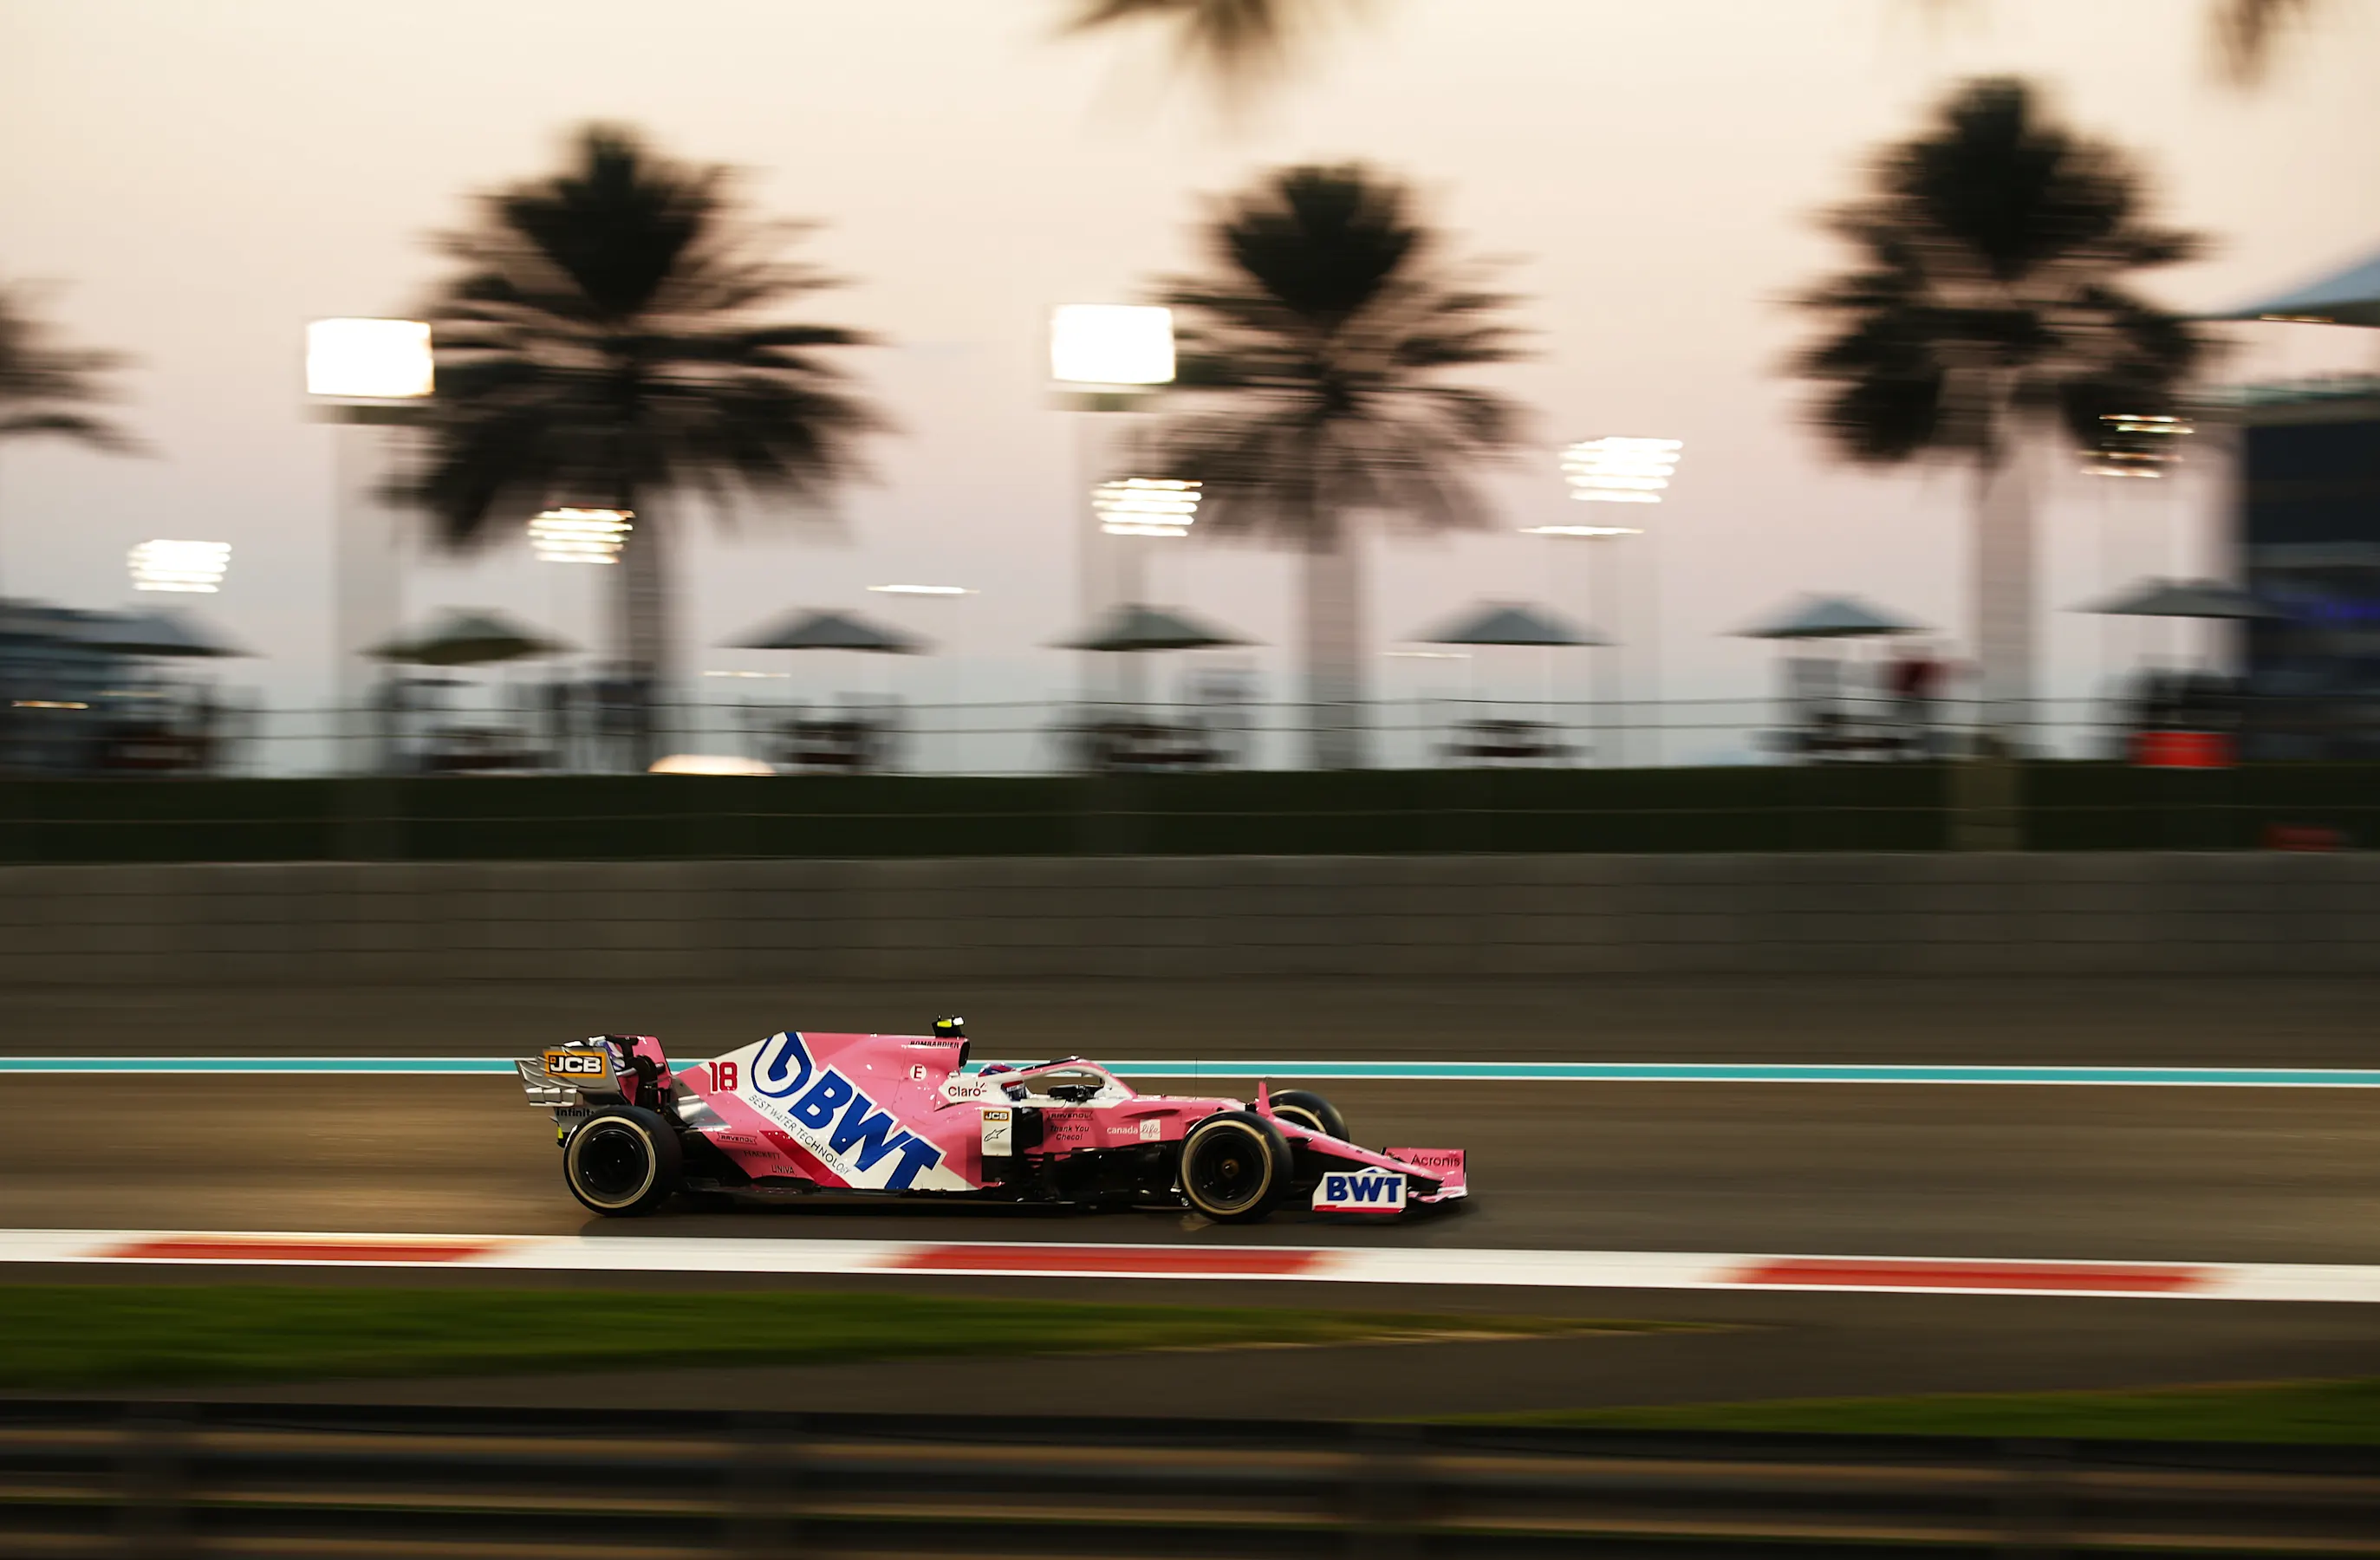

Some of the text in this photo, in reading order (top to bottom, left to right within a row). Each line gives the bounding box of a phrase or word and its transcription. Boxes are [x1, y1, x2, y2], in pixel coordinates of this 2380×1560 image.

[550, 1056, 601, 1072] JCB
[709, 1062, 738, 1091] 18
[914, 1065, 922, 1079] E
[948, 1086, 981, 1097] Claro
[748, 1095, 852, 1175] BEST WATER TECHNOLOGY
[788, 1069, 942, 1190] BWT
[1107, 1124, 1161, 1138] canada life
[721, 1134, 753, 1143] RAVENOL
[1411, 1154, 1460, 1167] Acronis
[771, 1164, 795, 1174] UNIVA
[1327, 1176, 1401, 1203] BWT
